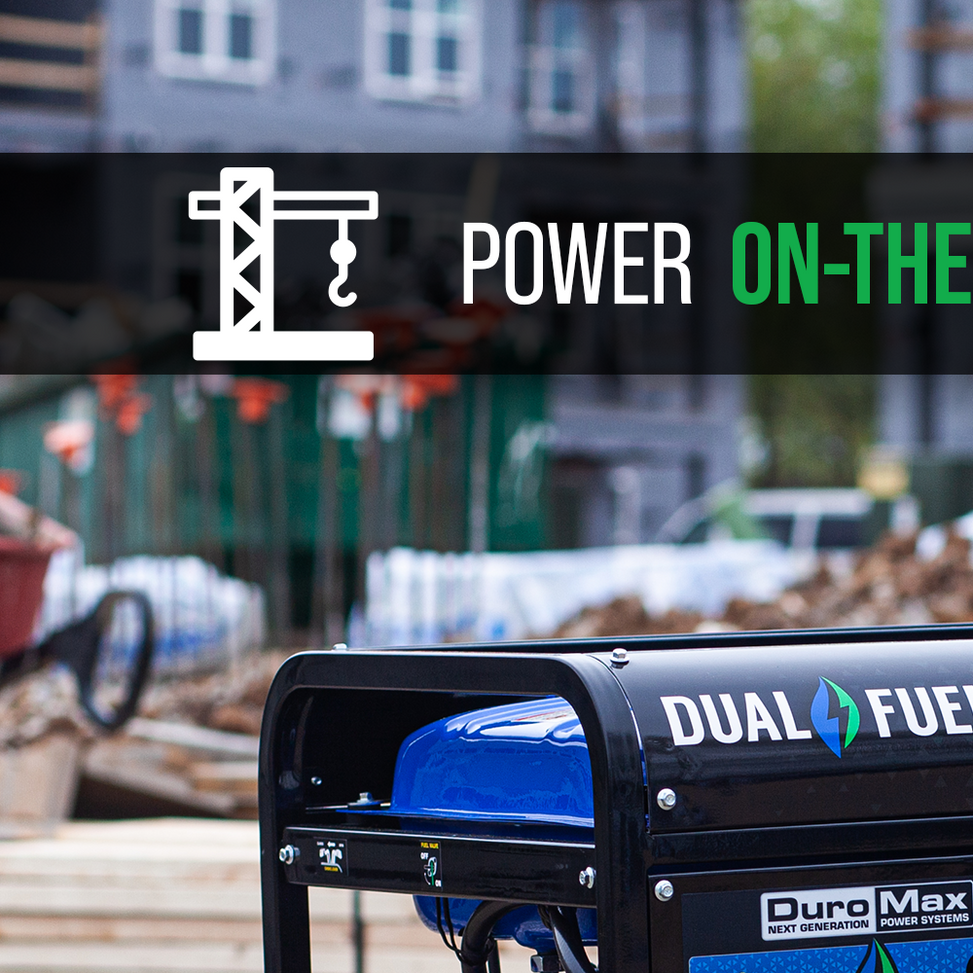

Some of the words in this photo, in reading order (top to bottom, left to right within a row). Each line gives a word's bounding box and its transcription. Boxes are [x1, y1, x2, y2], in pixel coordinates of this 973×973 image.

[660, 690, 812, 747] DUAL
[768, 923, 797, 935] NEXT
[799, 920, 869, 933] GENERATION
[881, 915, 919, 928] POWER
[921, 912, 970, 925] SYSTEMS
